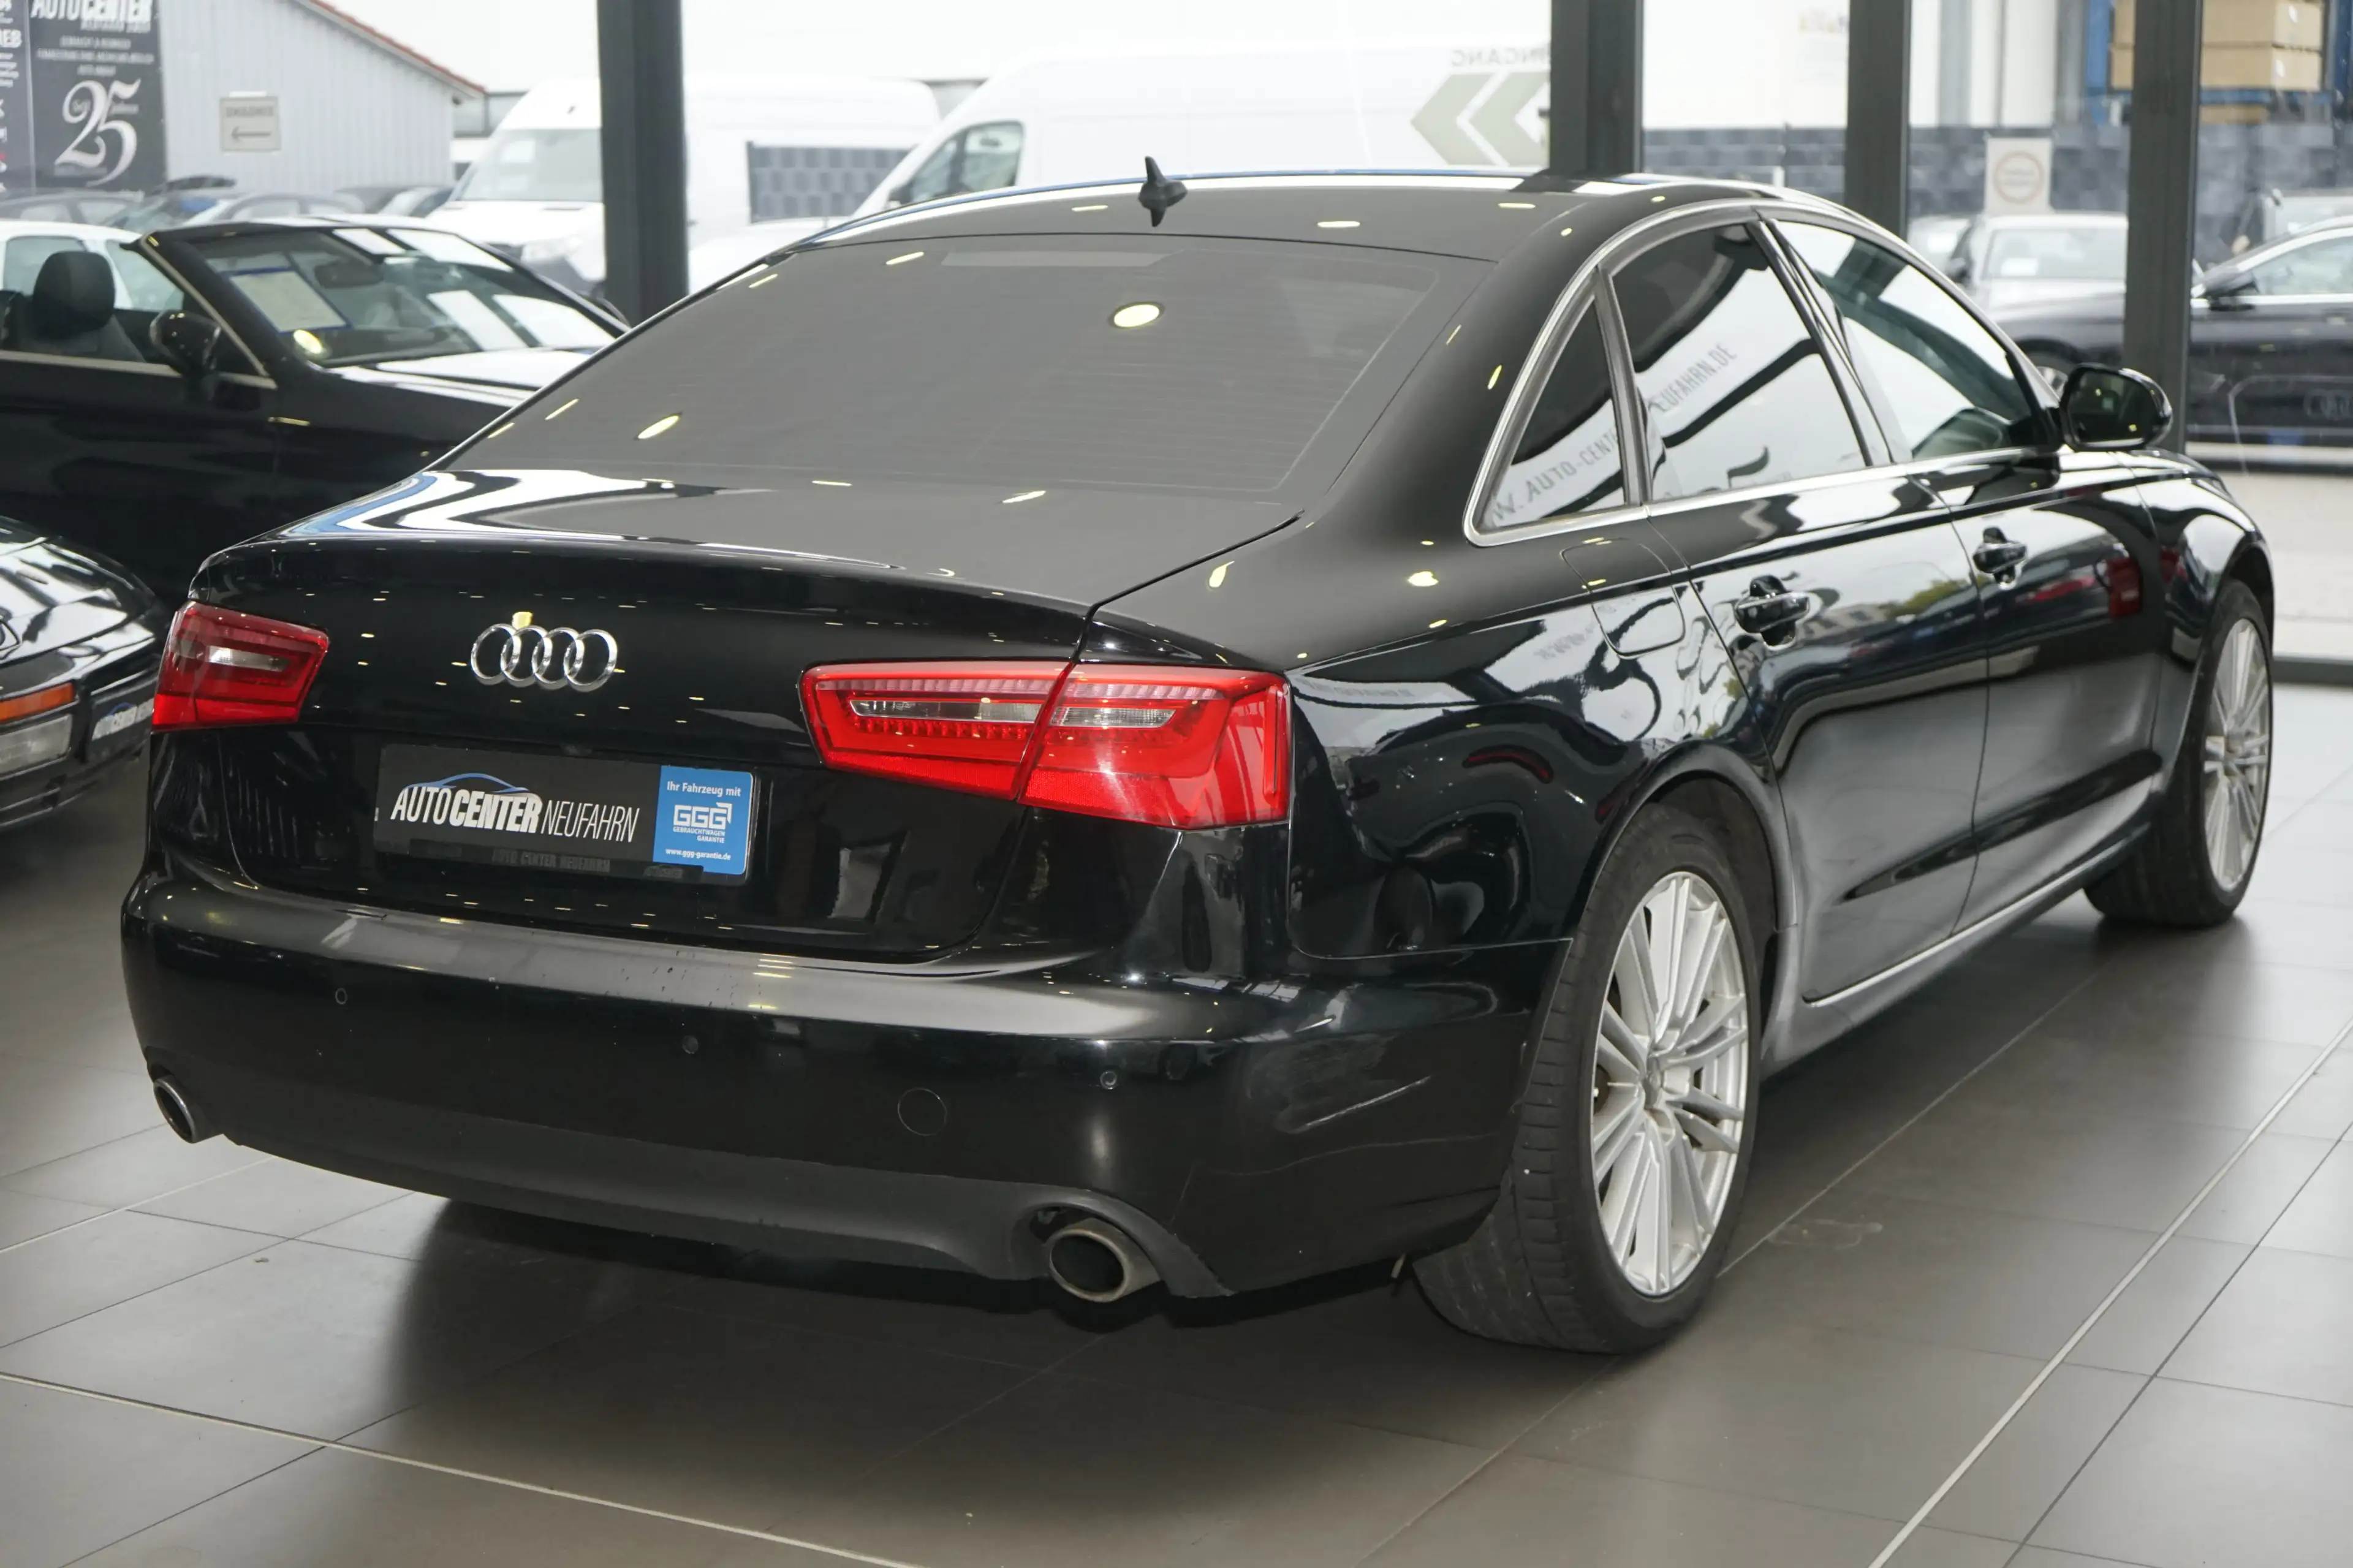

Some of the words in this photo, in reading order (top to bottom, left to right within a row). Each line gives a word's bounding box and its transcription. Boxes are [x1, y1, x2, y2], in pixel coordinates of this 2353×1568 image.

[54, 79, 142, 187] 25
[667, 781, 680, 792] Ihr
[682, 782, 723, 798] Fahrzeug
[726, 787, 741, 797] mit
[540, 799, 640, 843] NEUFAHRN
[673, 804, 728, 830] GGG
[673, 826, 726, 837] GEBRAUCHTWAGEN
[697, 835, 725, 844] GARANTIE
[665, 848, 732, 861] www.ggg-garantie.de
